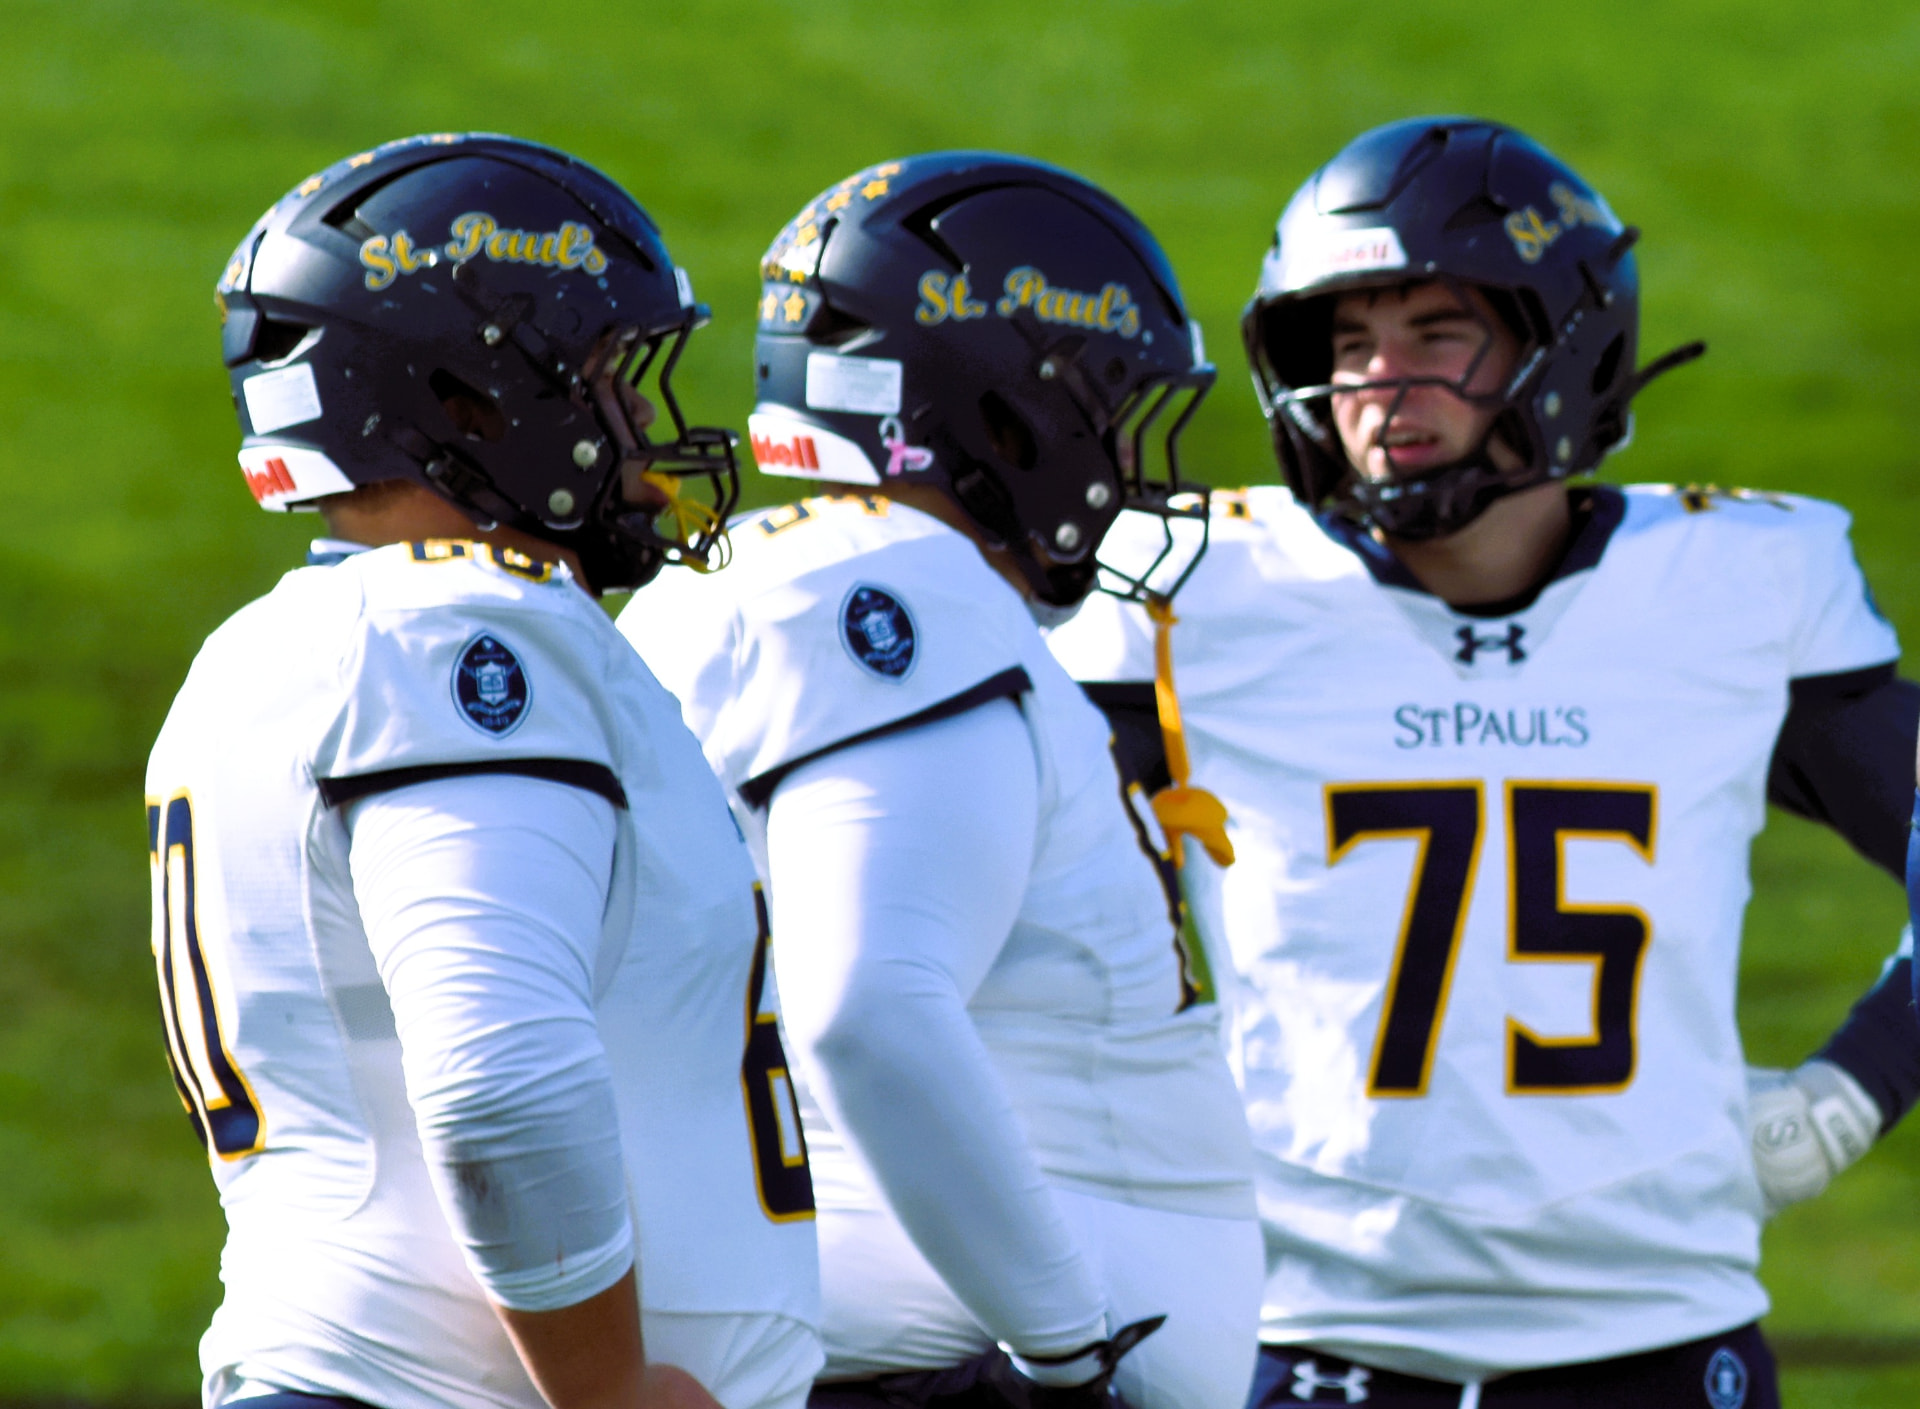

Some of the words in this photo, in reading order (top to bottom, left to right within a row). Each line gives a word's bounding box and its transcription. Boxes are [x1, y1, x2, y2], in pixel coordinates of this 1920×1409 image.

[445, 212, 608, 276] Paul's
[915, 270, 988, 326] St.
[996, 266, 1139, 339] Paul's
[1322, 778, 1660, 1098] 75
